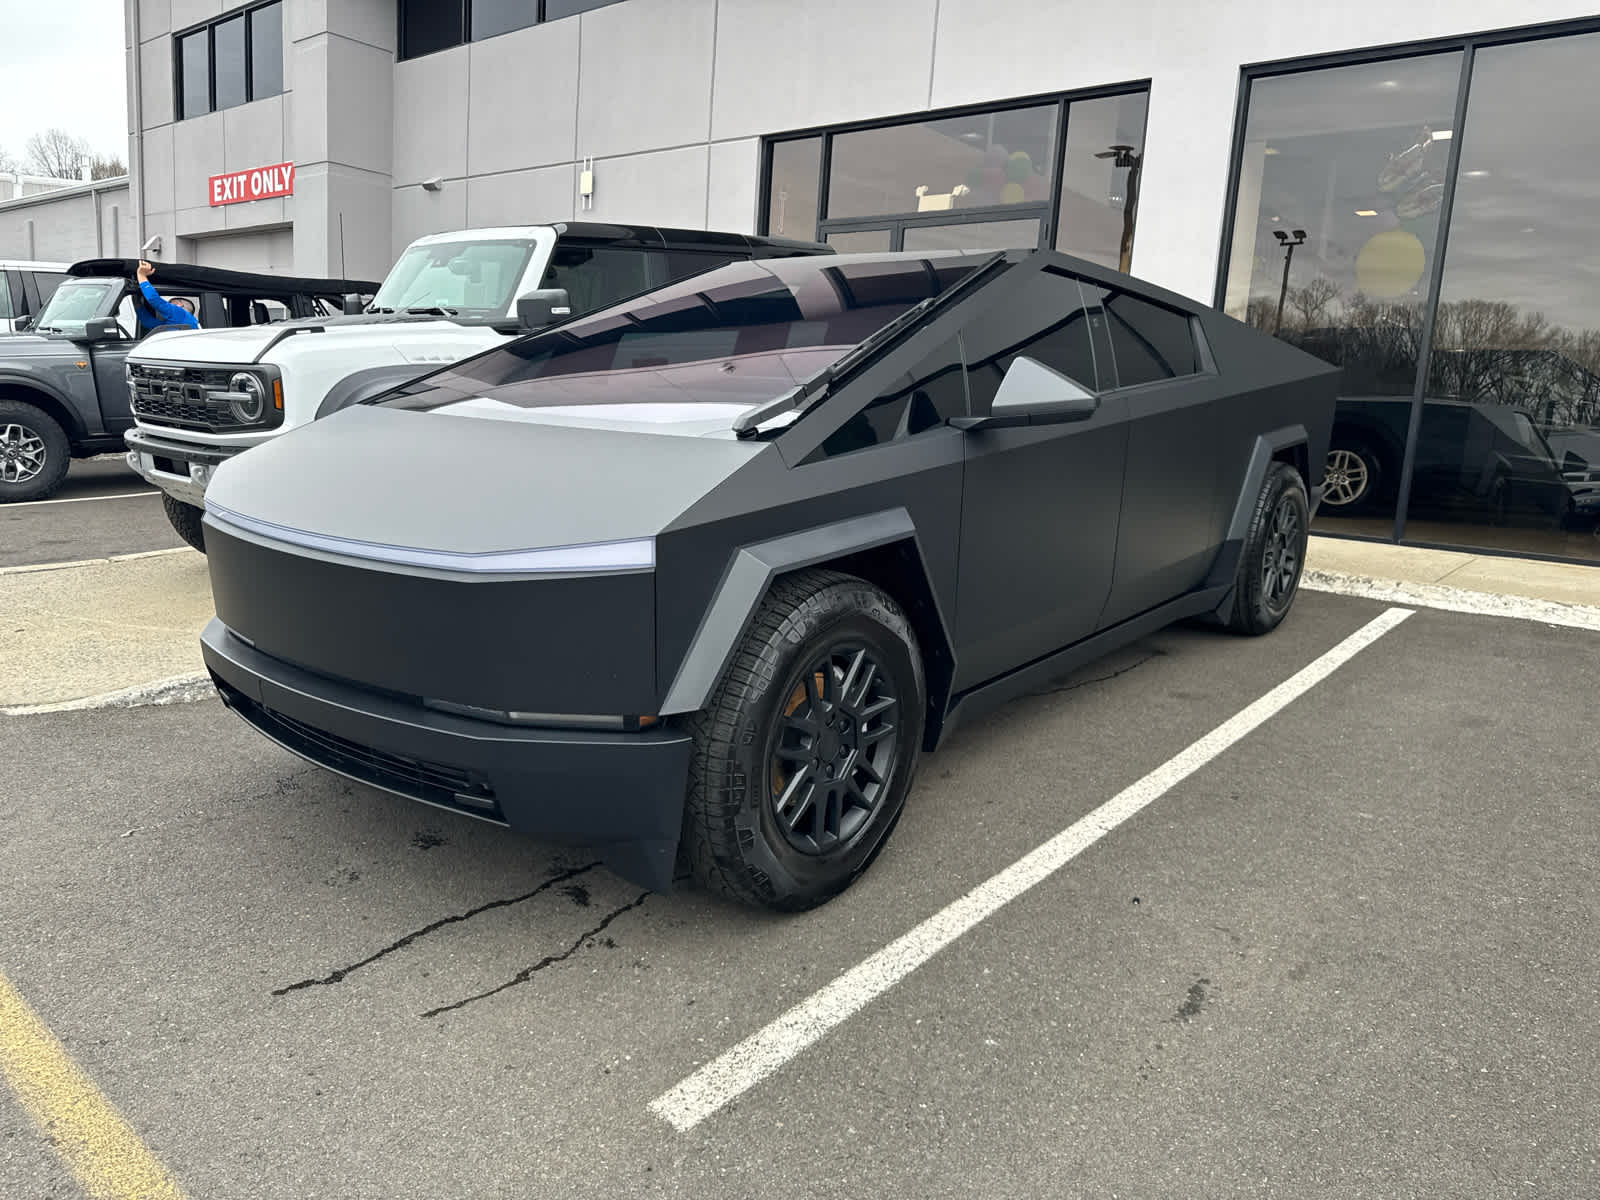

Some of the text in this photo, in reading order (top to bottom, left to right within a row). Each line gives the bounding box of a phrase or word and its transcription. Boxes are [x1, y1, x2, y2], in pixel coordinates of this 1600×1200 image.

[213, 165, 292, 202] EXIT ONLY
[135, 378, 206, 406] FORD
